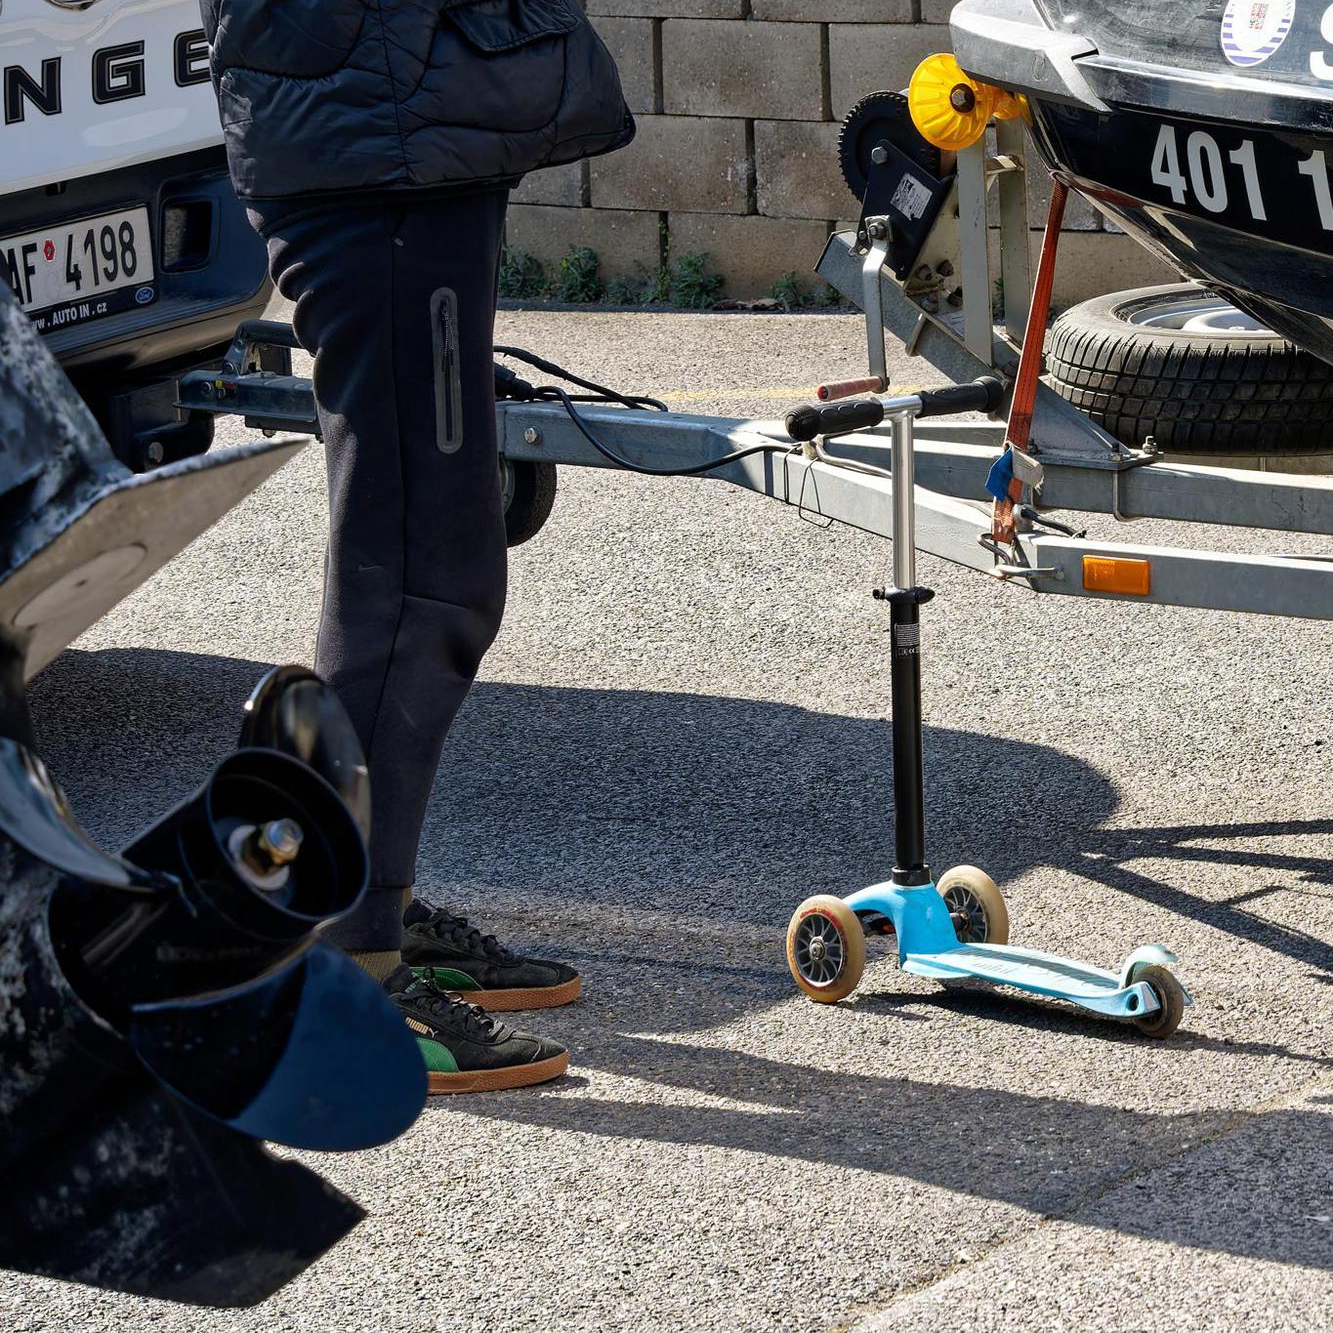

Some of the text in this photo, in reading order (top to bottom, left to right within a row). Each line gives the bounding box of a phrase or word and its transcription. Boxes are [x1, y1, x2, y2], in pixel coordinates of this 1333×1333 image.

[1150, 123, 1267, 222] 401
[65, 220, 137, 292] 4198
[52, 307, 78, 326] AUTO
[79, 304, 90, 319] IN
